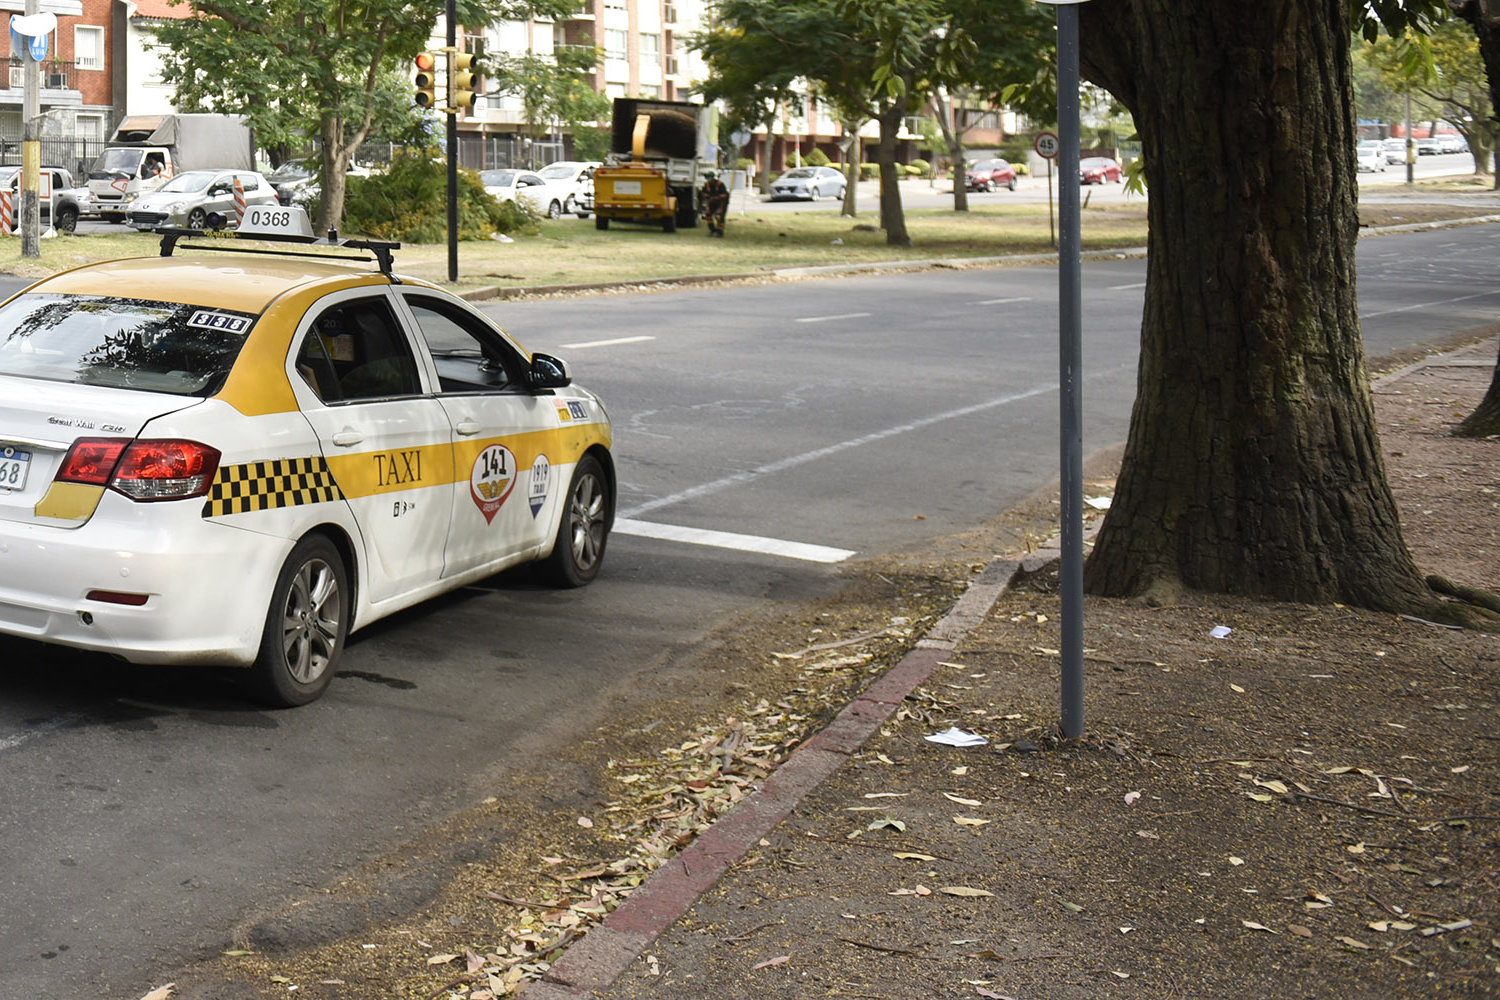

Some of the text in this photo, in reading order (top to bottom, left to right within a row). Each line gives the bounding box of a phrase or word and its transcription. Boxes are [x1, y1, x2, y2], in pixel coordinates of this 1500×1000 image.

[1039, 139, 1054, 150] 45
[251, 210, 290, 227] 0368
[197, 314, 243, 330] 338
[373, 449, 423, 487] TAXI
[481, 448, 507, 480] 141
[532, 463, 549, 482] 1919
[533, 483, 545, 495] TAXI
